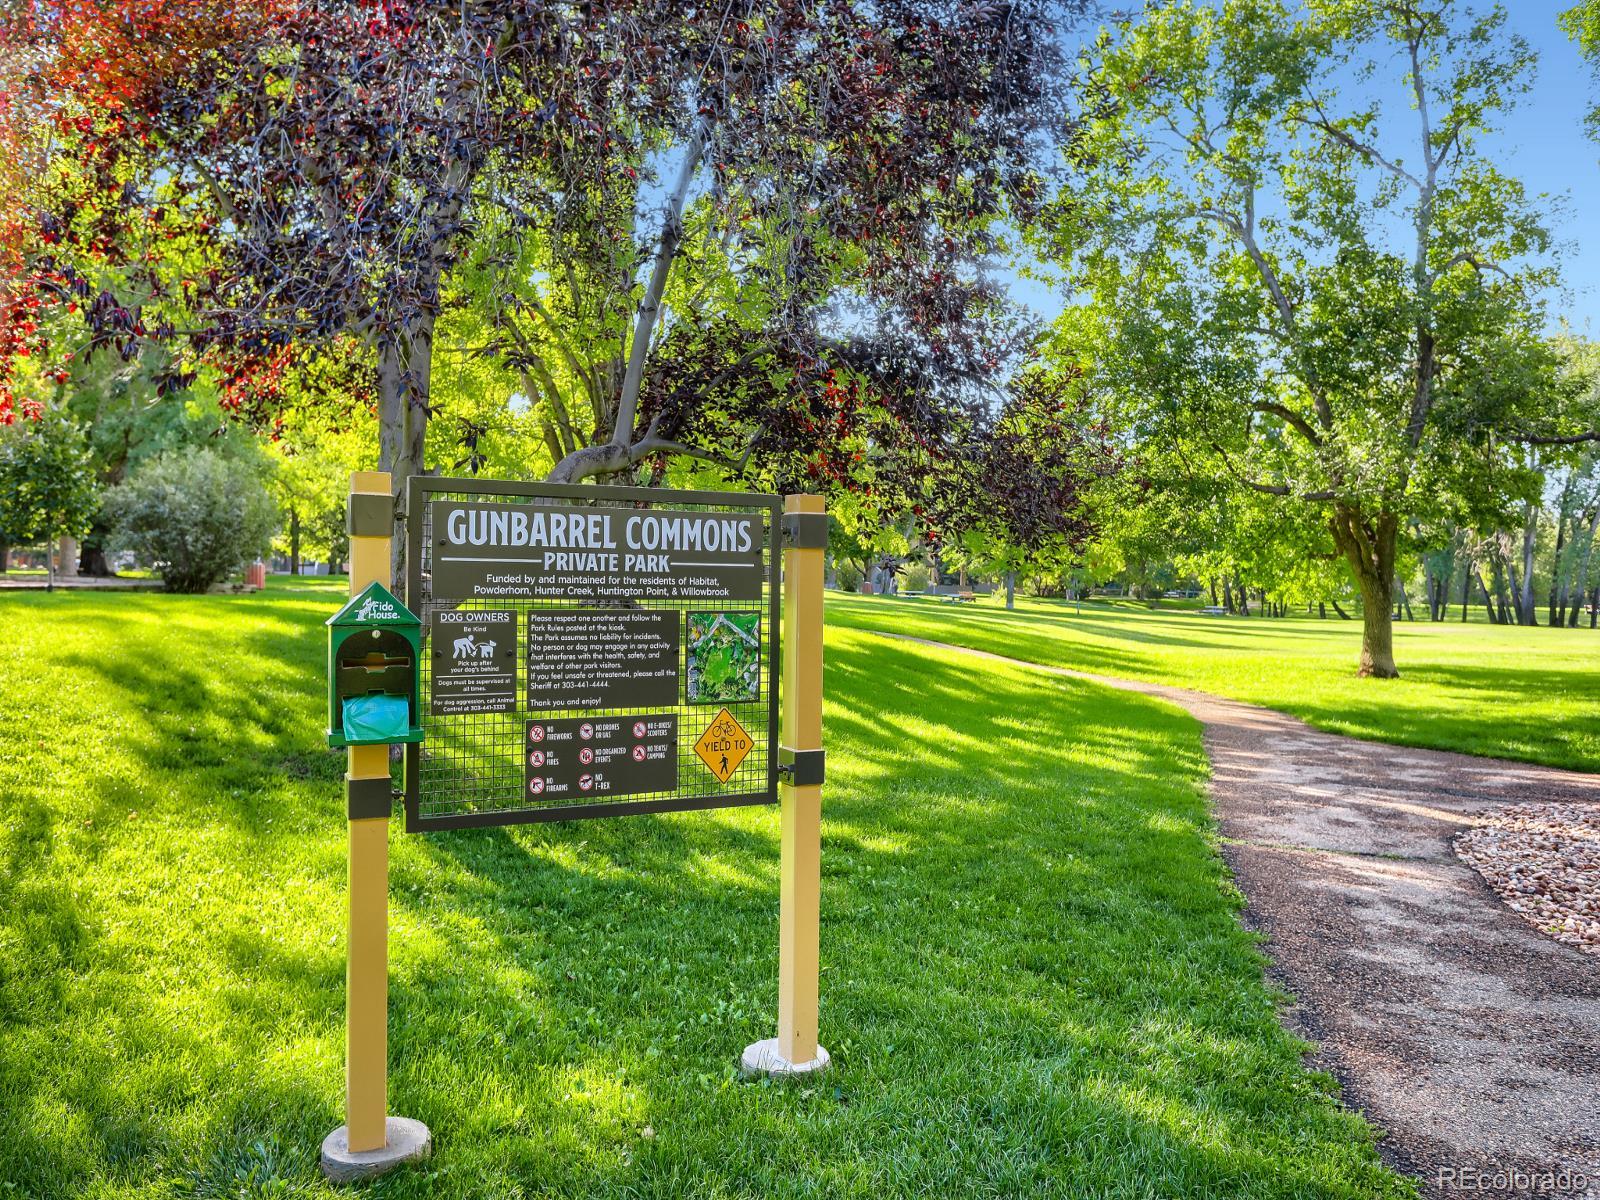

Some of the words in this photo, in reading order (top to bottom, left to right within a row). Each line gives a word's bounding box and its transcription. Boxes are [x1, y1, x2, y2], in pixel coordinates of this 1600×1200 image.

[447, 509, 616, 549] GUNBARREL
[625, 516, 752, 552] COMMONS
[544, 552, 618, 572] PRIVATE
[624, 554, 670, 573] PARK
[486, 574, 521, 584] Funded
[524, 575, 535, 586] by
[538, 575, 556, 585] and
[558, 575, 606, 585] maintained
[608, 576, 621, 585] for
[623, 576, 637, 586] the
[639, 576, 675, 586] residents
[677, 577, 686, 586] of
[688, 577, 720, 587] Habitat,
[474, 585, 532, 596] Powderhorn,
[534, 586, 565, 595] Hunter
[567, 586, 594, 596] Creek,
[597, 587, 644, 598] Huntington
[646, 587, 669, 597] Point,
[671, 588, 678, 596] &
[680, 588, 730, 597] Willowbrook
[373, 602, 393, 611] Fido
[440, 613, 463, 622] DOG
[467, 613, 510, 621] OWNERS
[650, 642, 670, 650] activity
[605, 652, 626, 660] health,
[584, 662, 598, 670] park
[582, 697, 601, 705] enjoy!
[704, 741, 730, 752] YIELD
[734, 740, 745, 750] TO
[546, 758, 559, 766] FIRES
[546, 784, 568, 792] FIREARMS
[595, 782, 610, 790] T-REX
